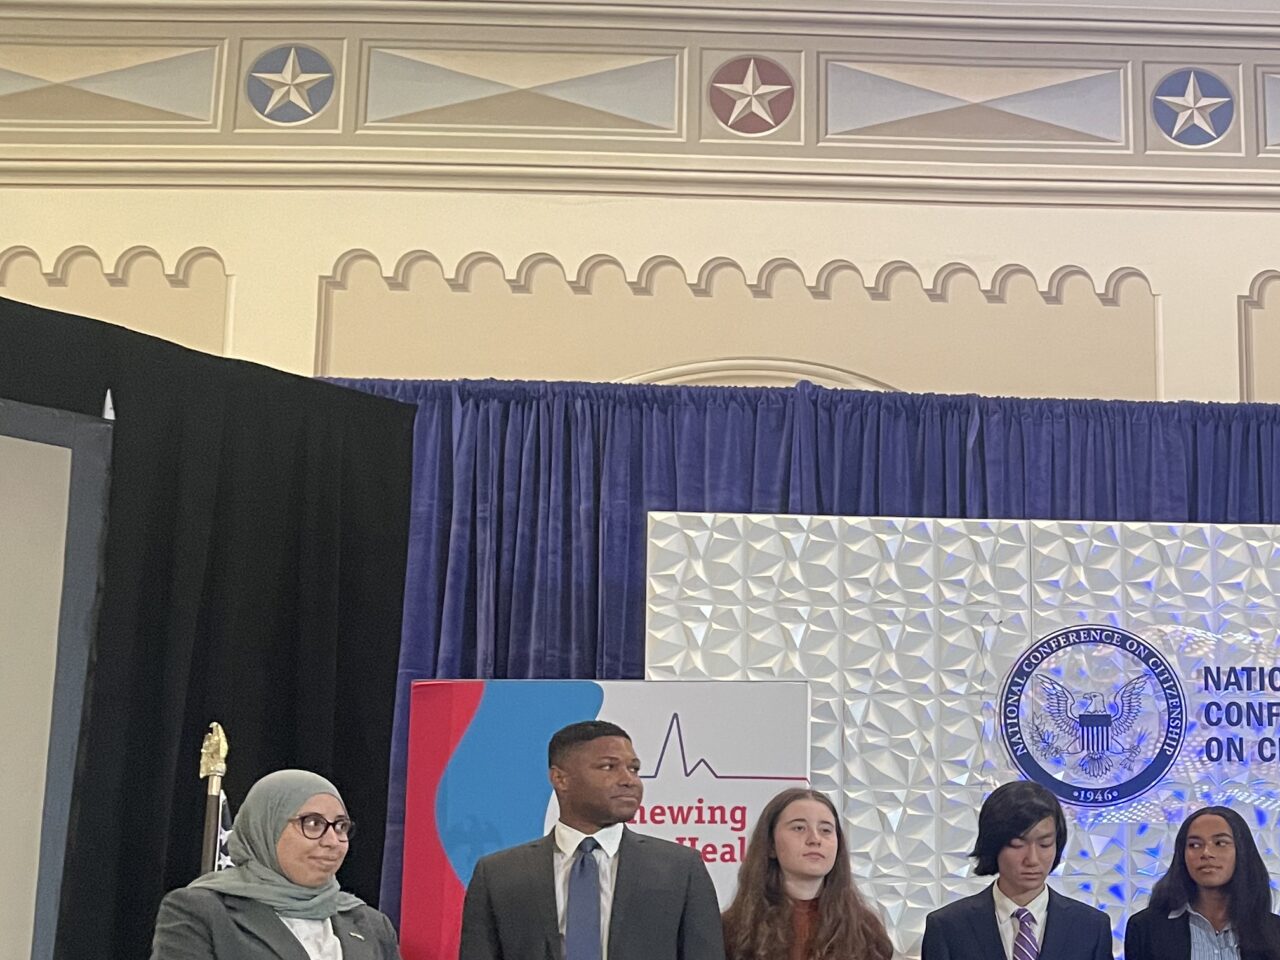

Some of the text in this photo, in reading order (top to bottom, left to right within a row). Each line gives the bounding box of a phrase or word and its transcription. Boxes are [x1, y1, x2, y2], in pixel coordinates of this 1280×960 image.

[1007, 630, 1182, 756] NATIONAL CONFERENCE ON CITIZENSHIP
[1205, 737, 1245, 763] ON
